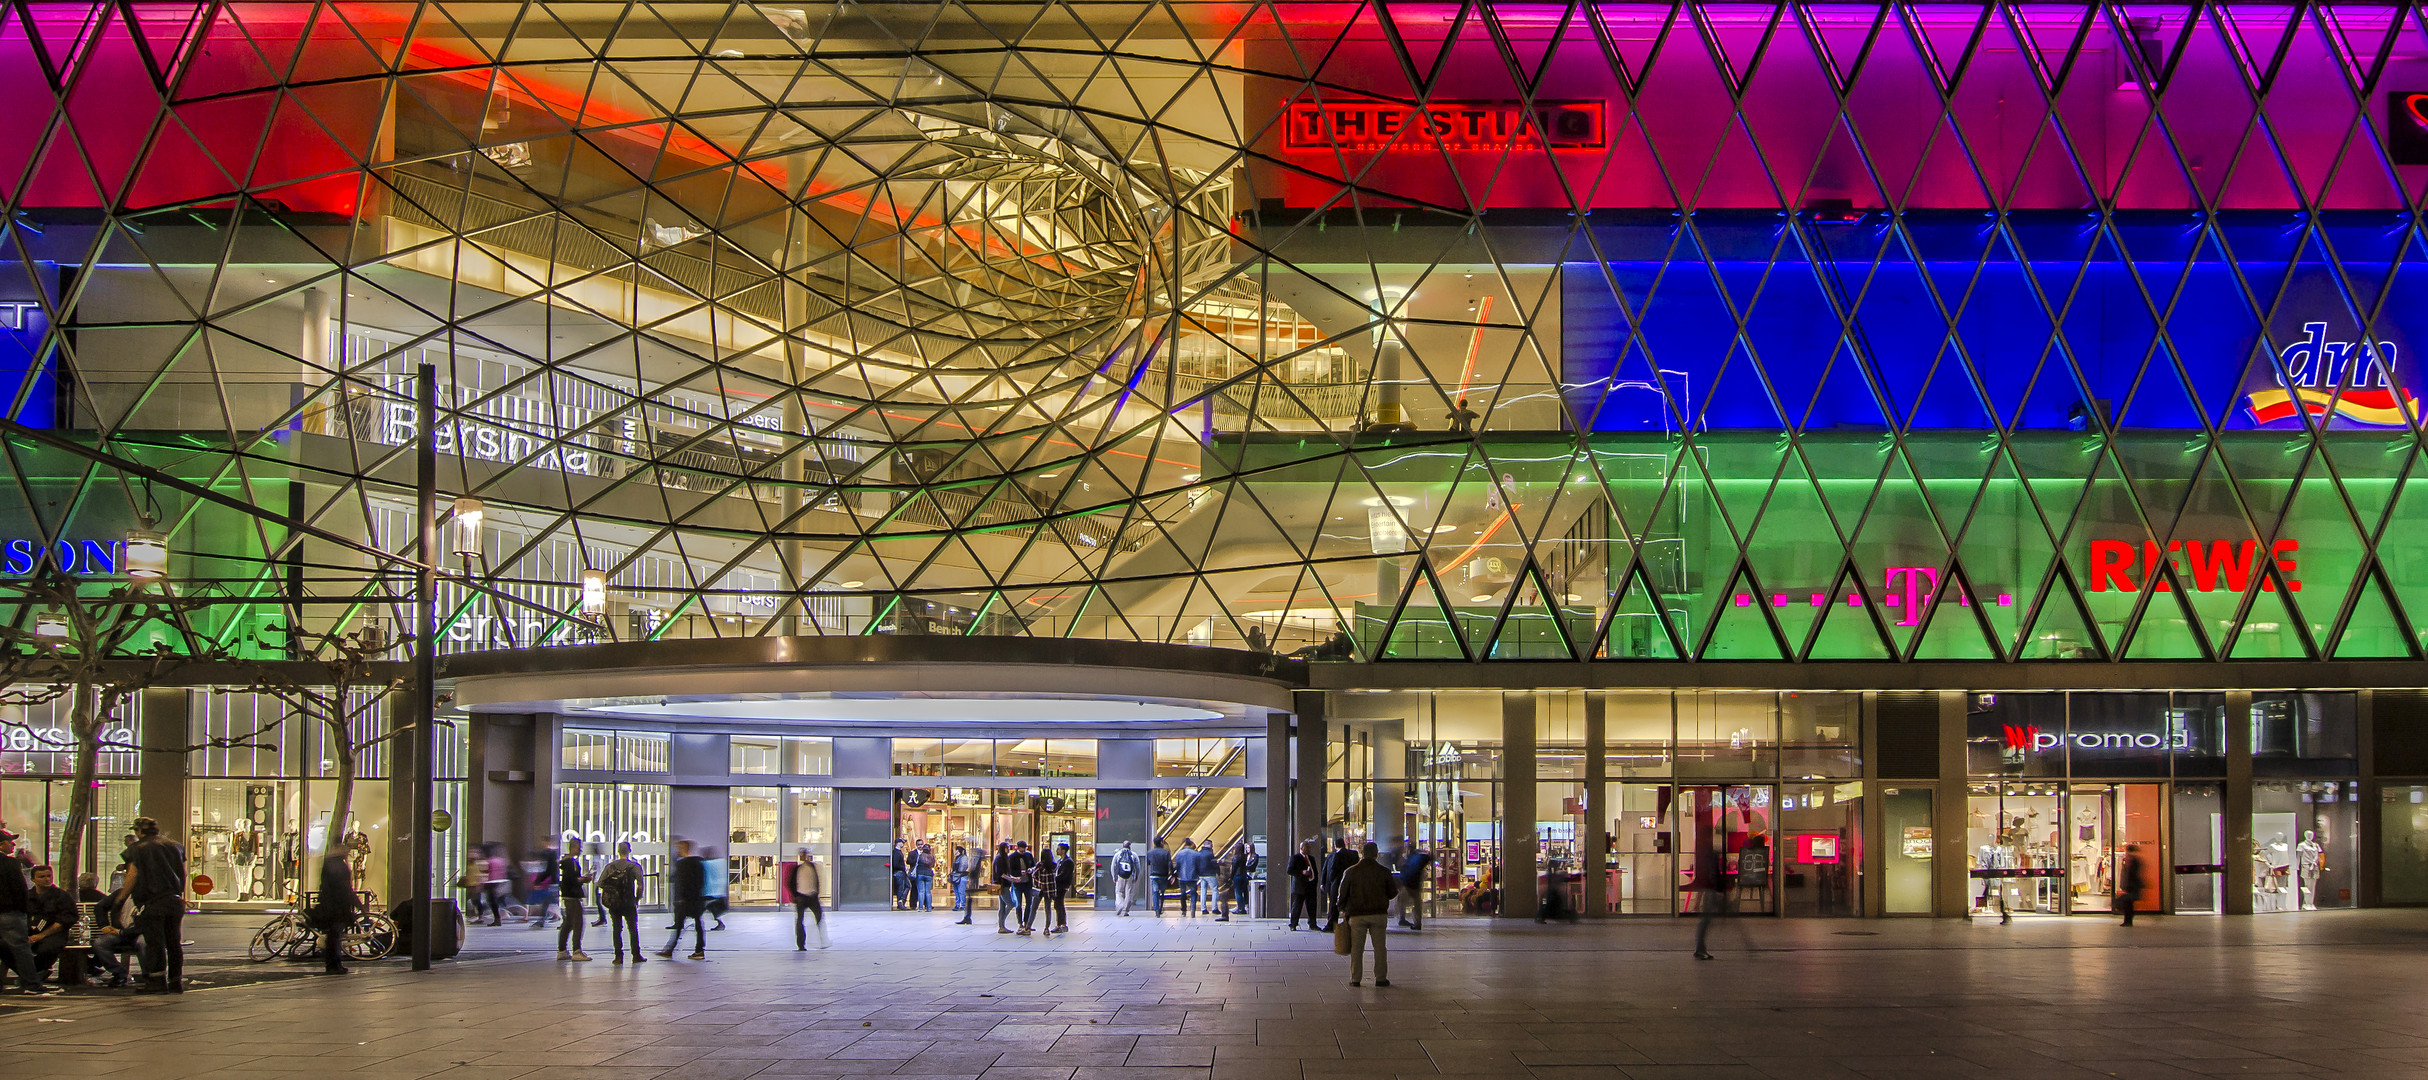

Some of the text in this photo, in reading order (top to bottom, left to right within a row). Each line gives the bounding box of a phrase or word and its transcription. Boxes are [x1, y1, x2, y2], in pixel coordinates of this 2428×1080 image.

[1300, 110, 1589, 139] THE STING
[0, 301, 40, 330] T
[2276, 321, 2398, 388] dm
[4, 539, 127, 575] SON
[2090, 539, 2302, 592] REWE
[1885, 567, 1937, 626] T
[0, 723, 134, 752] erska
[2032, 730, 2189, 753] promod
